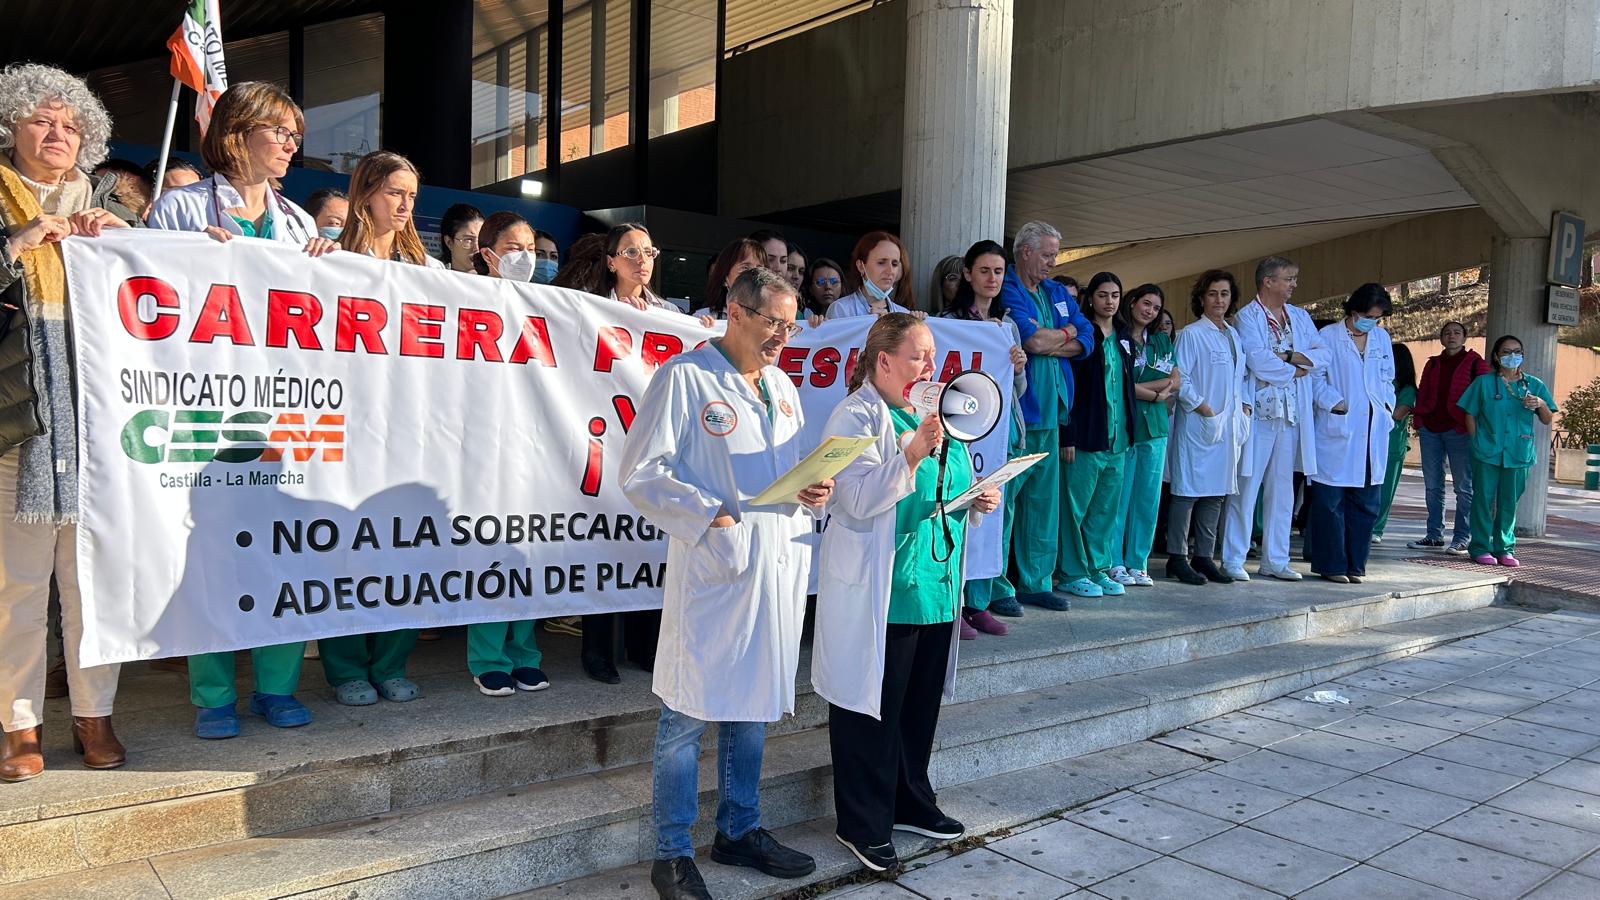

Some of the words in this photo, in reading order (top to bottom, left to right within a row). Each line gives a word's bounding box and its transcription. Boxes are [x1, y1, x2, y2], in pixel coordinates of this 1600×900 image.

[1560, 222, 1576, 276] P
[117, 275, 558, 368] CARRERA
[120, 368, 246, 407] SINDICATO
[254, 369, 343, 410] MÉDICO
[120, 409, 345, 464] CESM
[160, 472, 211, 488] Castilla
[226, 472, 244, 486] La
[249, 470, 304, 486] Mancha
[273, 518, 339, 554] NO
[351, 517, 380, 550] A
[392, 515, 440, 548] LA
[272, 561, 533, 618] ADECUACIÓN
[544, 564, 586, 595] DE
